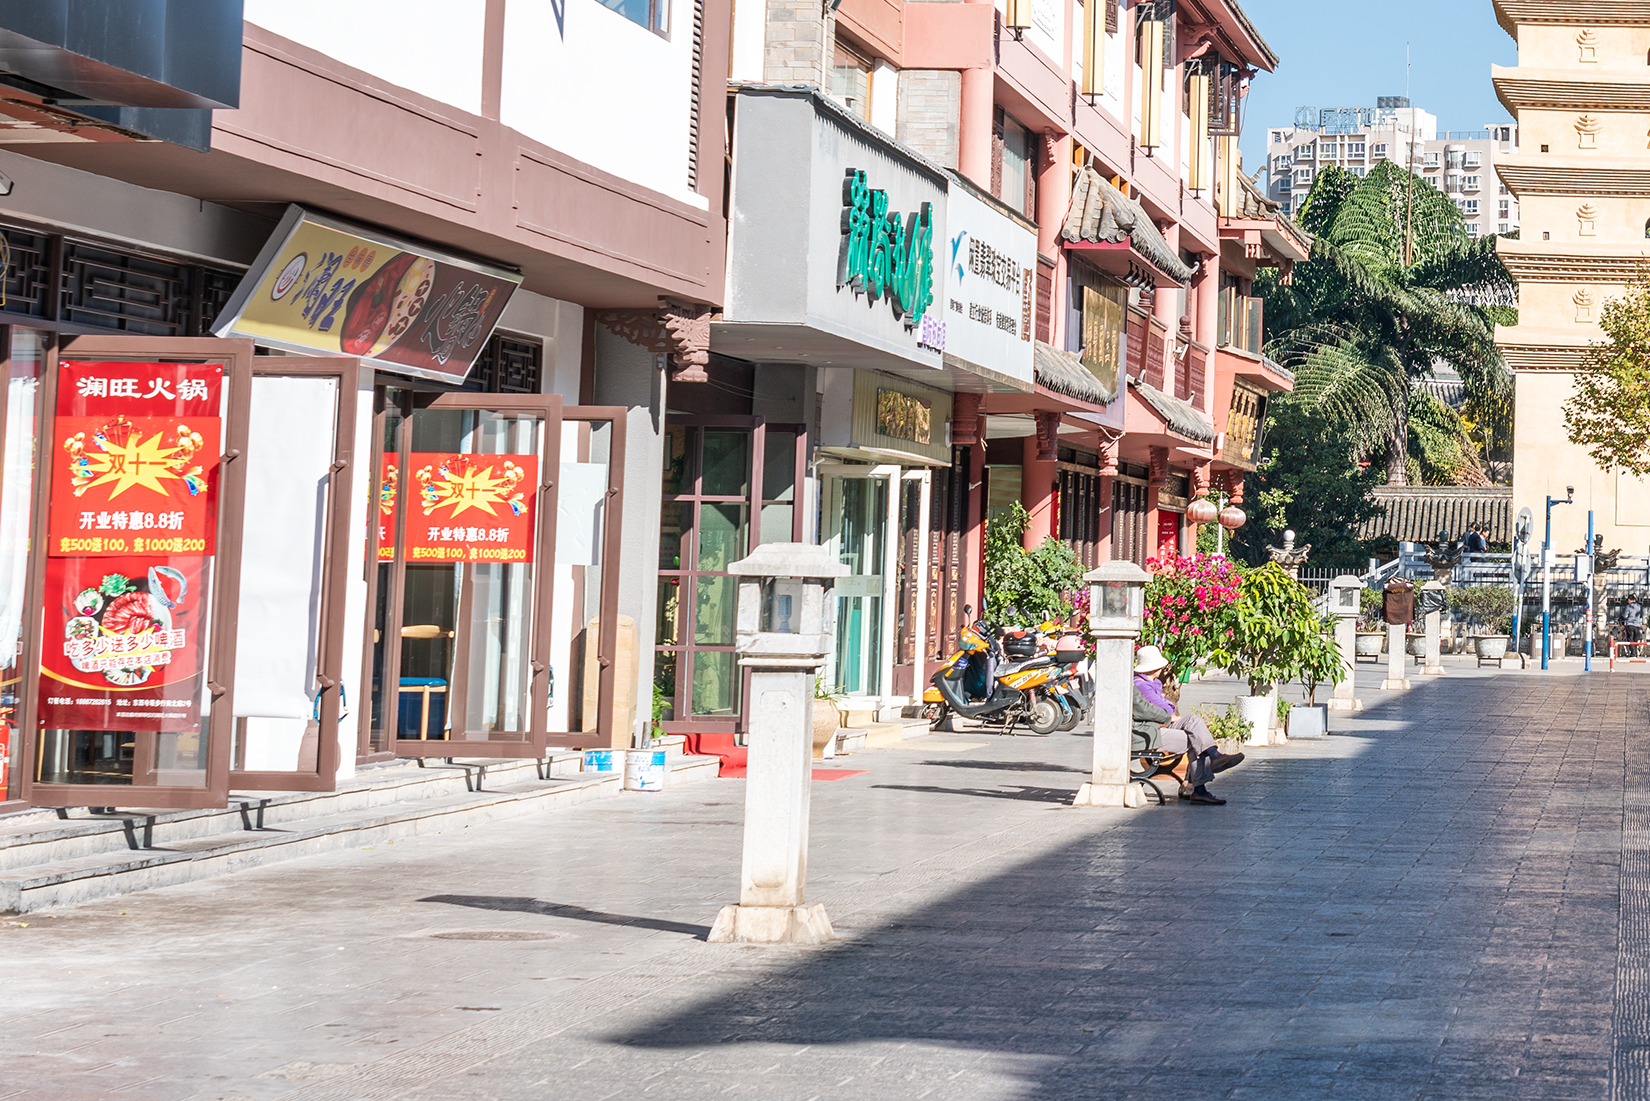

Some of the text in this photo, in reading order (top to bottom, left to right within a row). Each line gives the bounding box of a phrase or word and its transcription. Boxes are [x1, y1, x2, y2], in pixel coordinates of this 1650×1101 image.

[76, 376, 208, 401] 澜旺火锅
[109, 453, 168, 475] 双十一
[451, 482, 496, 499] 双十一
[79, 511, 184, 530] 开业特惠8.8折
[427, 527, 509, 542] 开业特惠8.8折
[65, 630, 184, 658] 吃多少送多少啤酒
[81, 654, 170, 670] 啤酒只能存在本店消费
